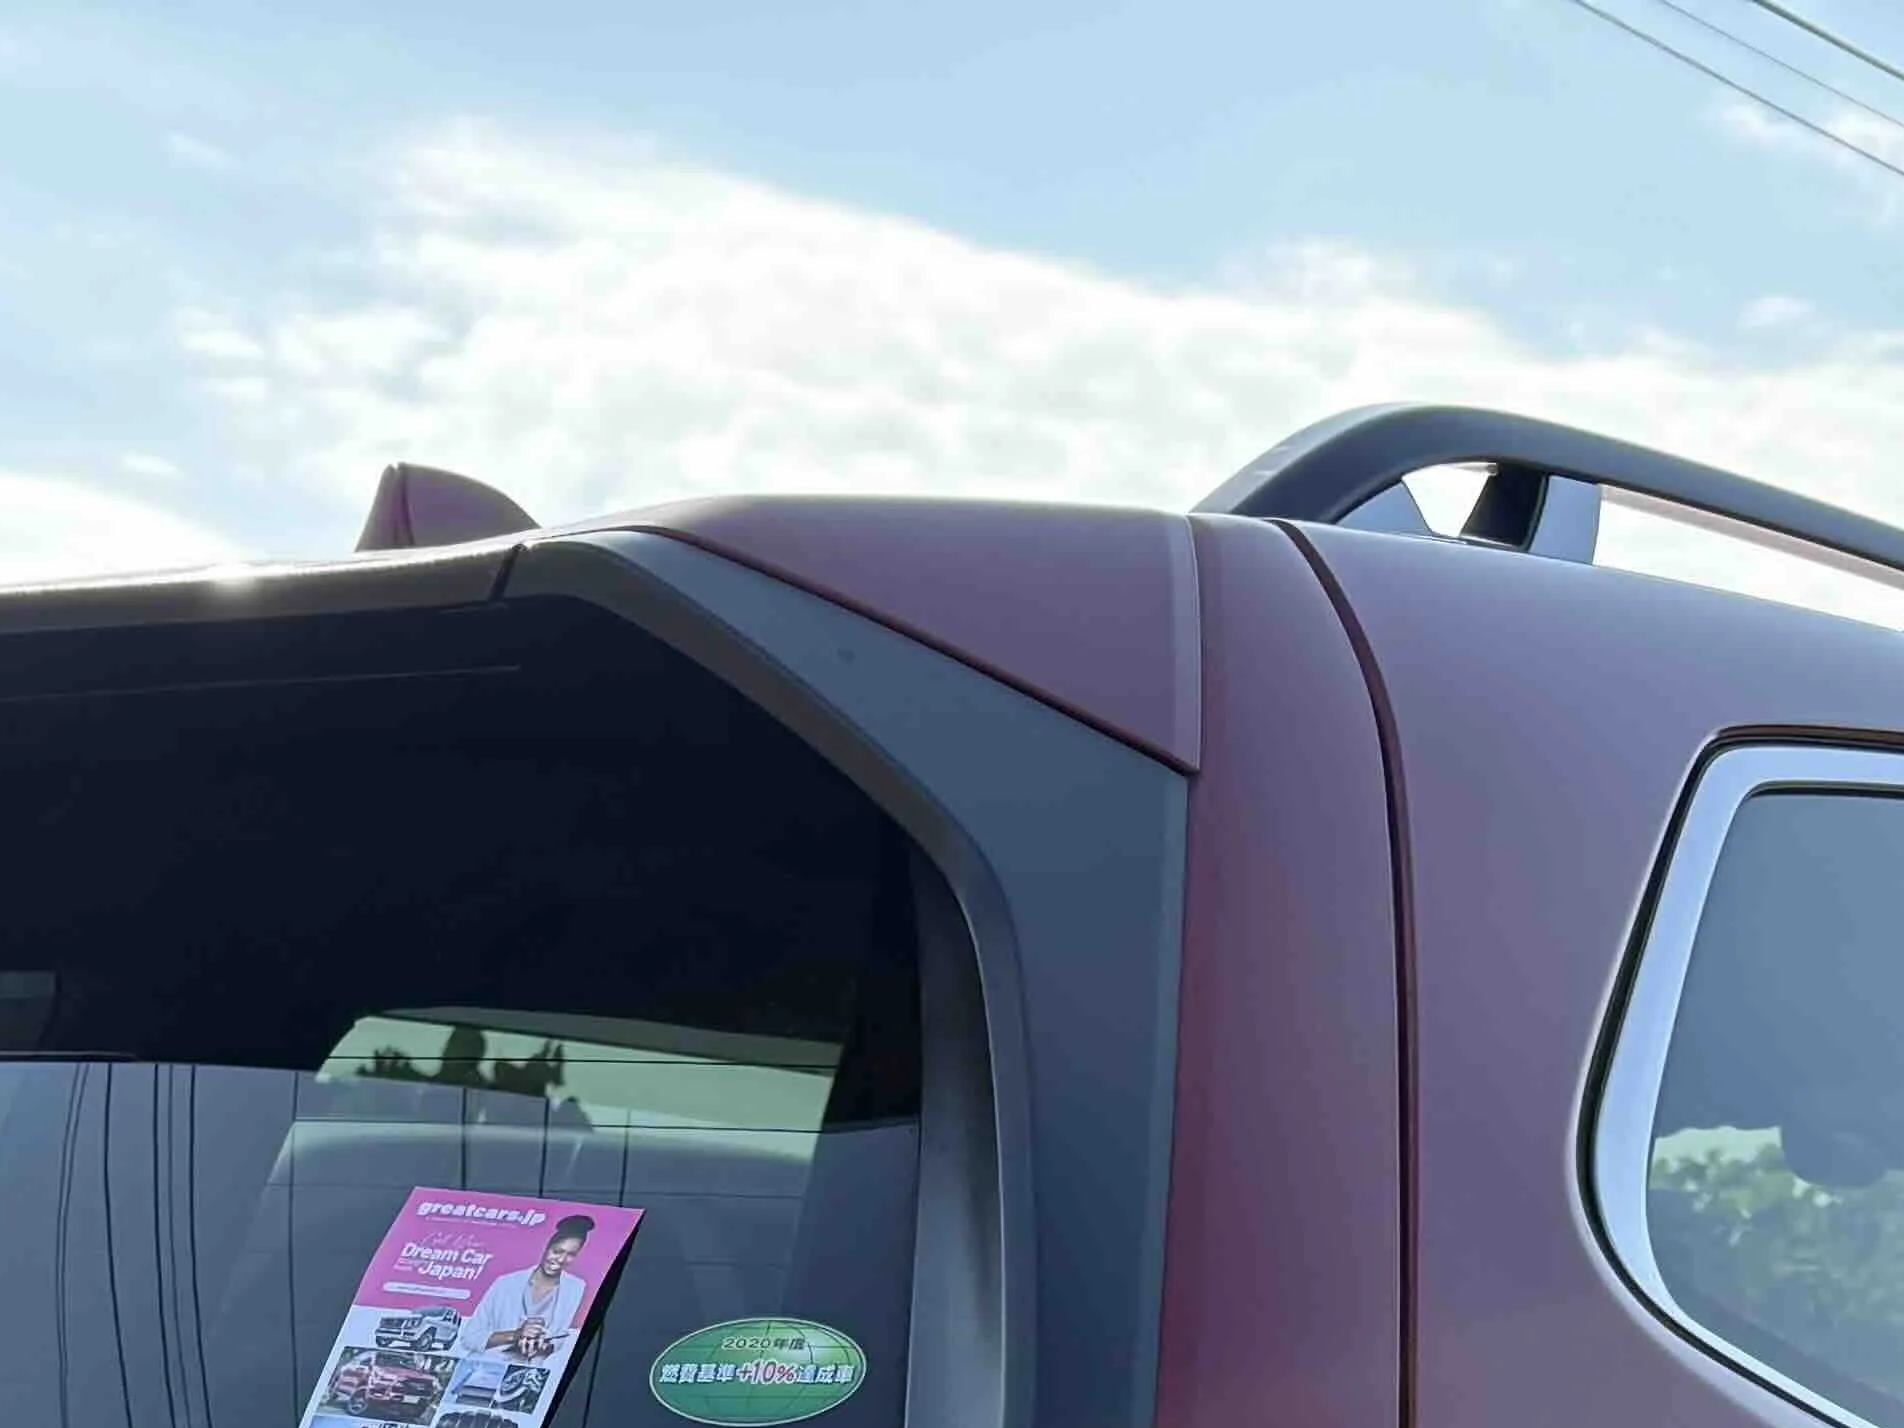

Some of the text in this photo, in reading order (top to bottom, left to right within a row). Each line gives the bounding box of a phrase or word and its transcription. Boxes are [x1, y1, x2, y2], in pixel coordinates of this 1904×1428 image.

[417, 1200, 546, 1225] greatcars.jp
[400, 1242, 494, 1266] Dream Car
[418, 1259, 484, 1281] Japan!
[723, 1336, 806, 1351] 2020年度
